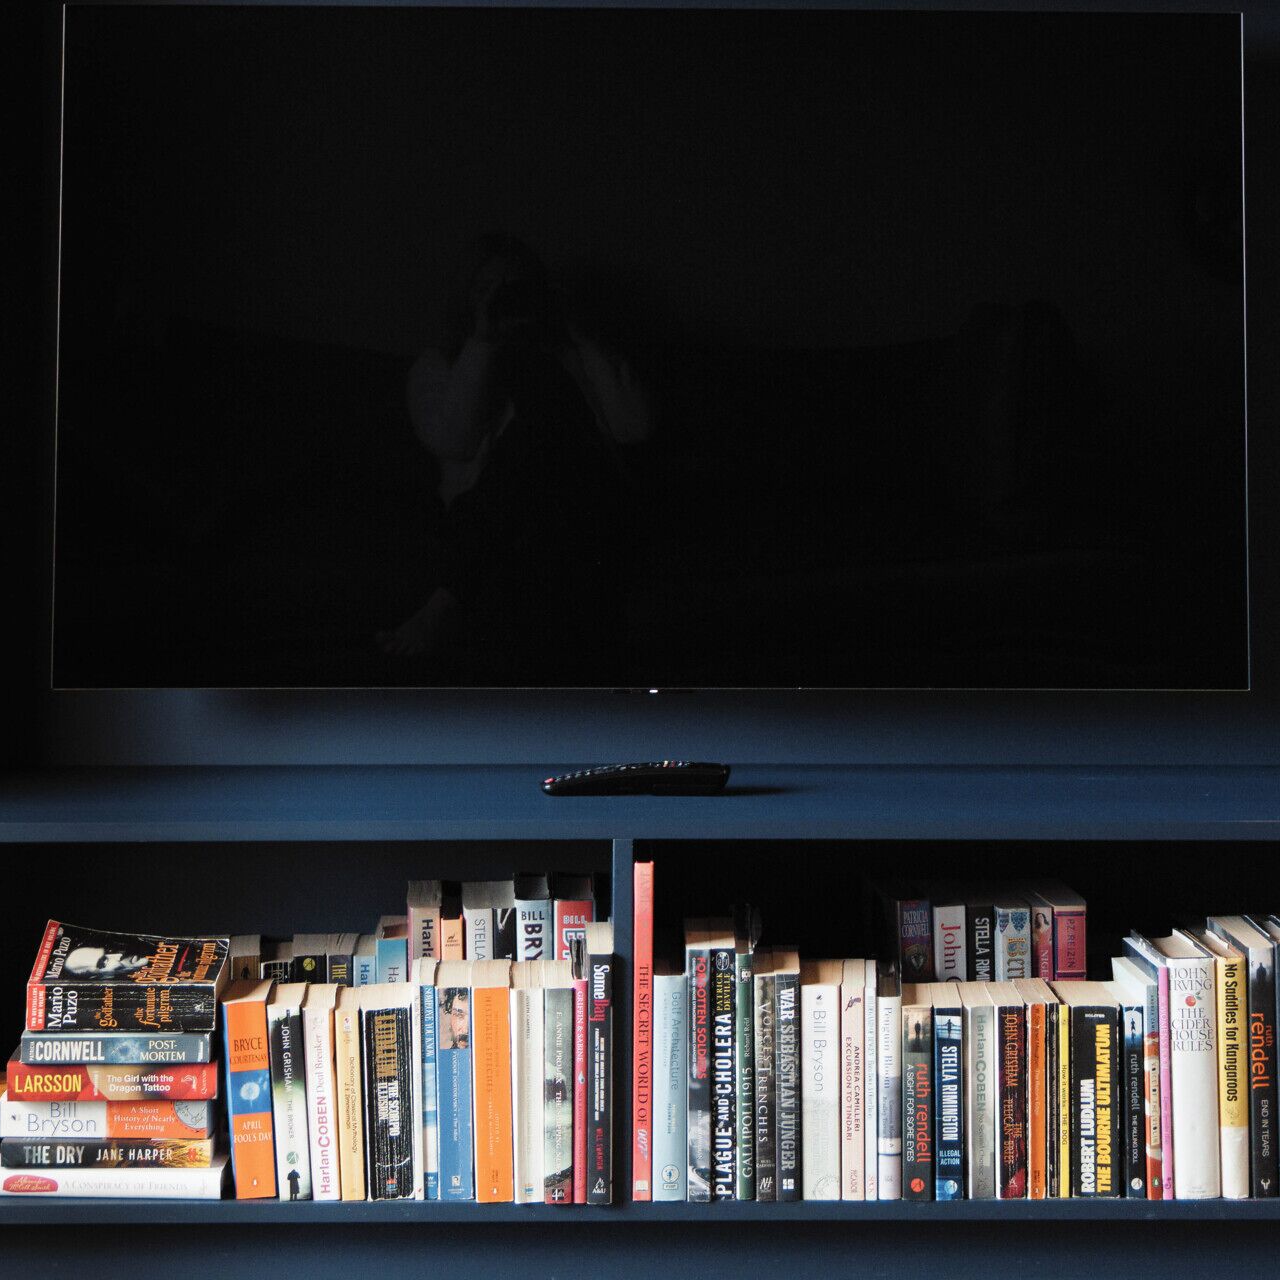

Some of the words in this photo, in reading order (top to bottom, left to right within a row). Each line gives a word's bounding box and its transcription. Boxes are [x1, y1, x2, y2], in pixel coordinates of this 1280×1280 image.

[1224, 964, 1238, 978] No
[48, 987, 63, 1028] Mario
[63, 991, 77, 1024] Puzo
[781, 988, 795, 1020] WAR
[1224, 980, 1238, 1024] Saddles
[35, 1041, 105, 1060] CORNWELL
[234, 1036, 262, 1051] BRYCE
[1226, 1028, 1237, 1041] for
[1250, 1012, 1269, 1090] rendell
[716, 1014, 731, 1093] CHOLERA
[781, 1024, 795, 1106] SEBASTIAN
[942, 1046, 957, 1081] STELLA
[1096, 1024, 1110, 1107] ULTIMATUM
[15, 1075, 82, 1093] LARSSON
[107, 1075, 121, 1083] The
[124, 1075, 138, 1083] Girl
[141, 1075, 158, 1083] with
[160, 1074, 174, 1083] the
[110, 1084, 137, 1093] Dragon
[140, 1084, 171, 1092] Tattoo
[743, 1067, 753, 1093] 1915
[916, 1063, 931, 1098] ruth
[1226, 1044, 1239, 1102] Kangaroos
[27, 1114, 97, 1135] Bryson
[719, 1097, 728, 1120] AND
[942, 1084, 958, 1140] RIMINGTON
[1080, 1079, 1094, 1137] LUDLUM
[742, 1098, 753, 1178] GALLIPOLI
[781, 1109, 795, 1171] JUNGER
[916, 1106, 931, 1163] rendell
[1097, 1108, 1111, 1163] BOURNE
[23, 1146, 49, 1164] THE
[56, 1145, 85, 1164] DRY
[96, 1143, 124, 1161] JANE
[129, 1143, 173, 1161] HARPER
[716, 1126, 732, 1194] PLAGUE
[1080, 1139, 1094, 1192] ROBERT
[1097, 1166, 1111, 1192] THE
